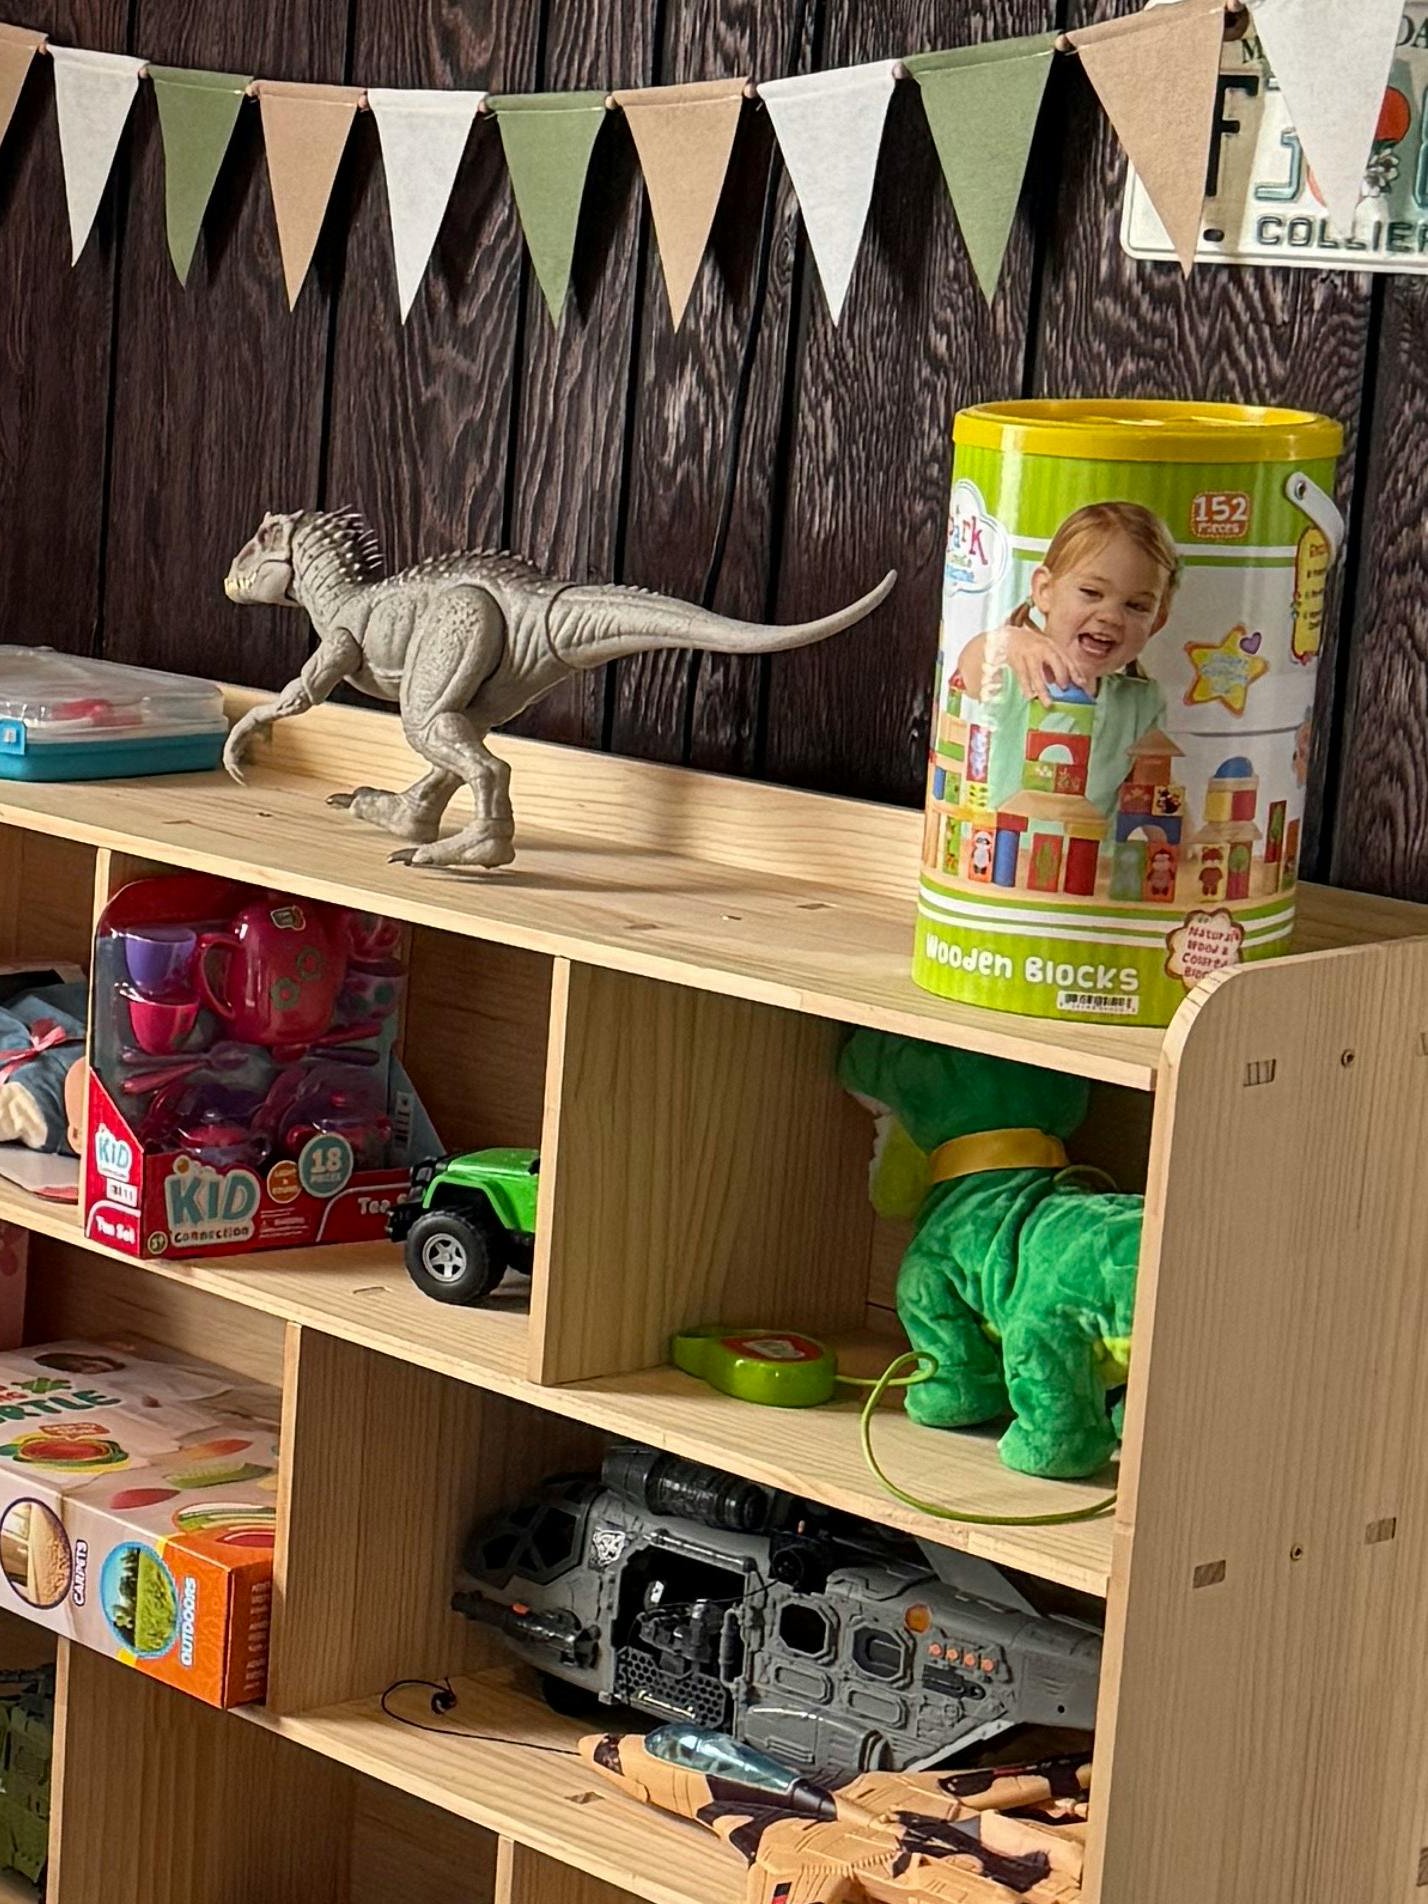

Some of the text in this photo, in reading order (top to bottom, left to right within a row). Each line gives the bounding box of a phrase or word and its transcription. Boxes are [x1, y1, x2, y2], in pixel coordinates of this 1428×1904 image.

[1193, 496, 1248, 521] 152
[926, 932, 1013, 978] Wooden
[98, 1136, 131, 1168] KID
[312, 1147, 343, 1173] 18
[169, 1175, 256, 1227] KID
[357, 1197, 392, 1215] Tea
[73, 1539, 89, 1606] CARPETS
[180, 1577, 197, 1668] OUTDOORS
